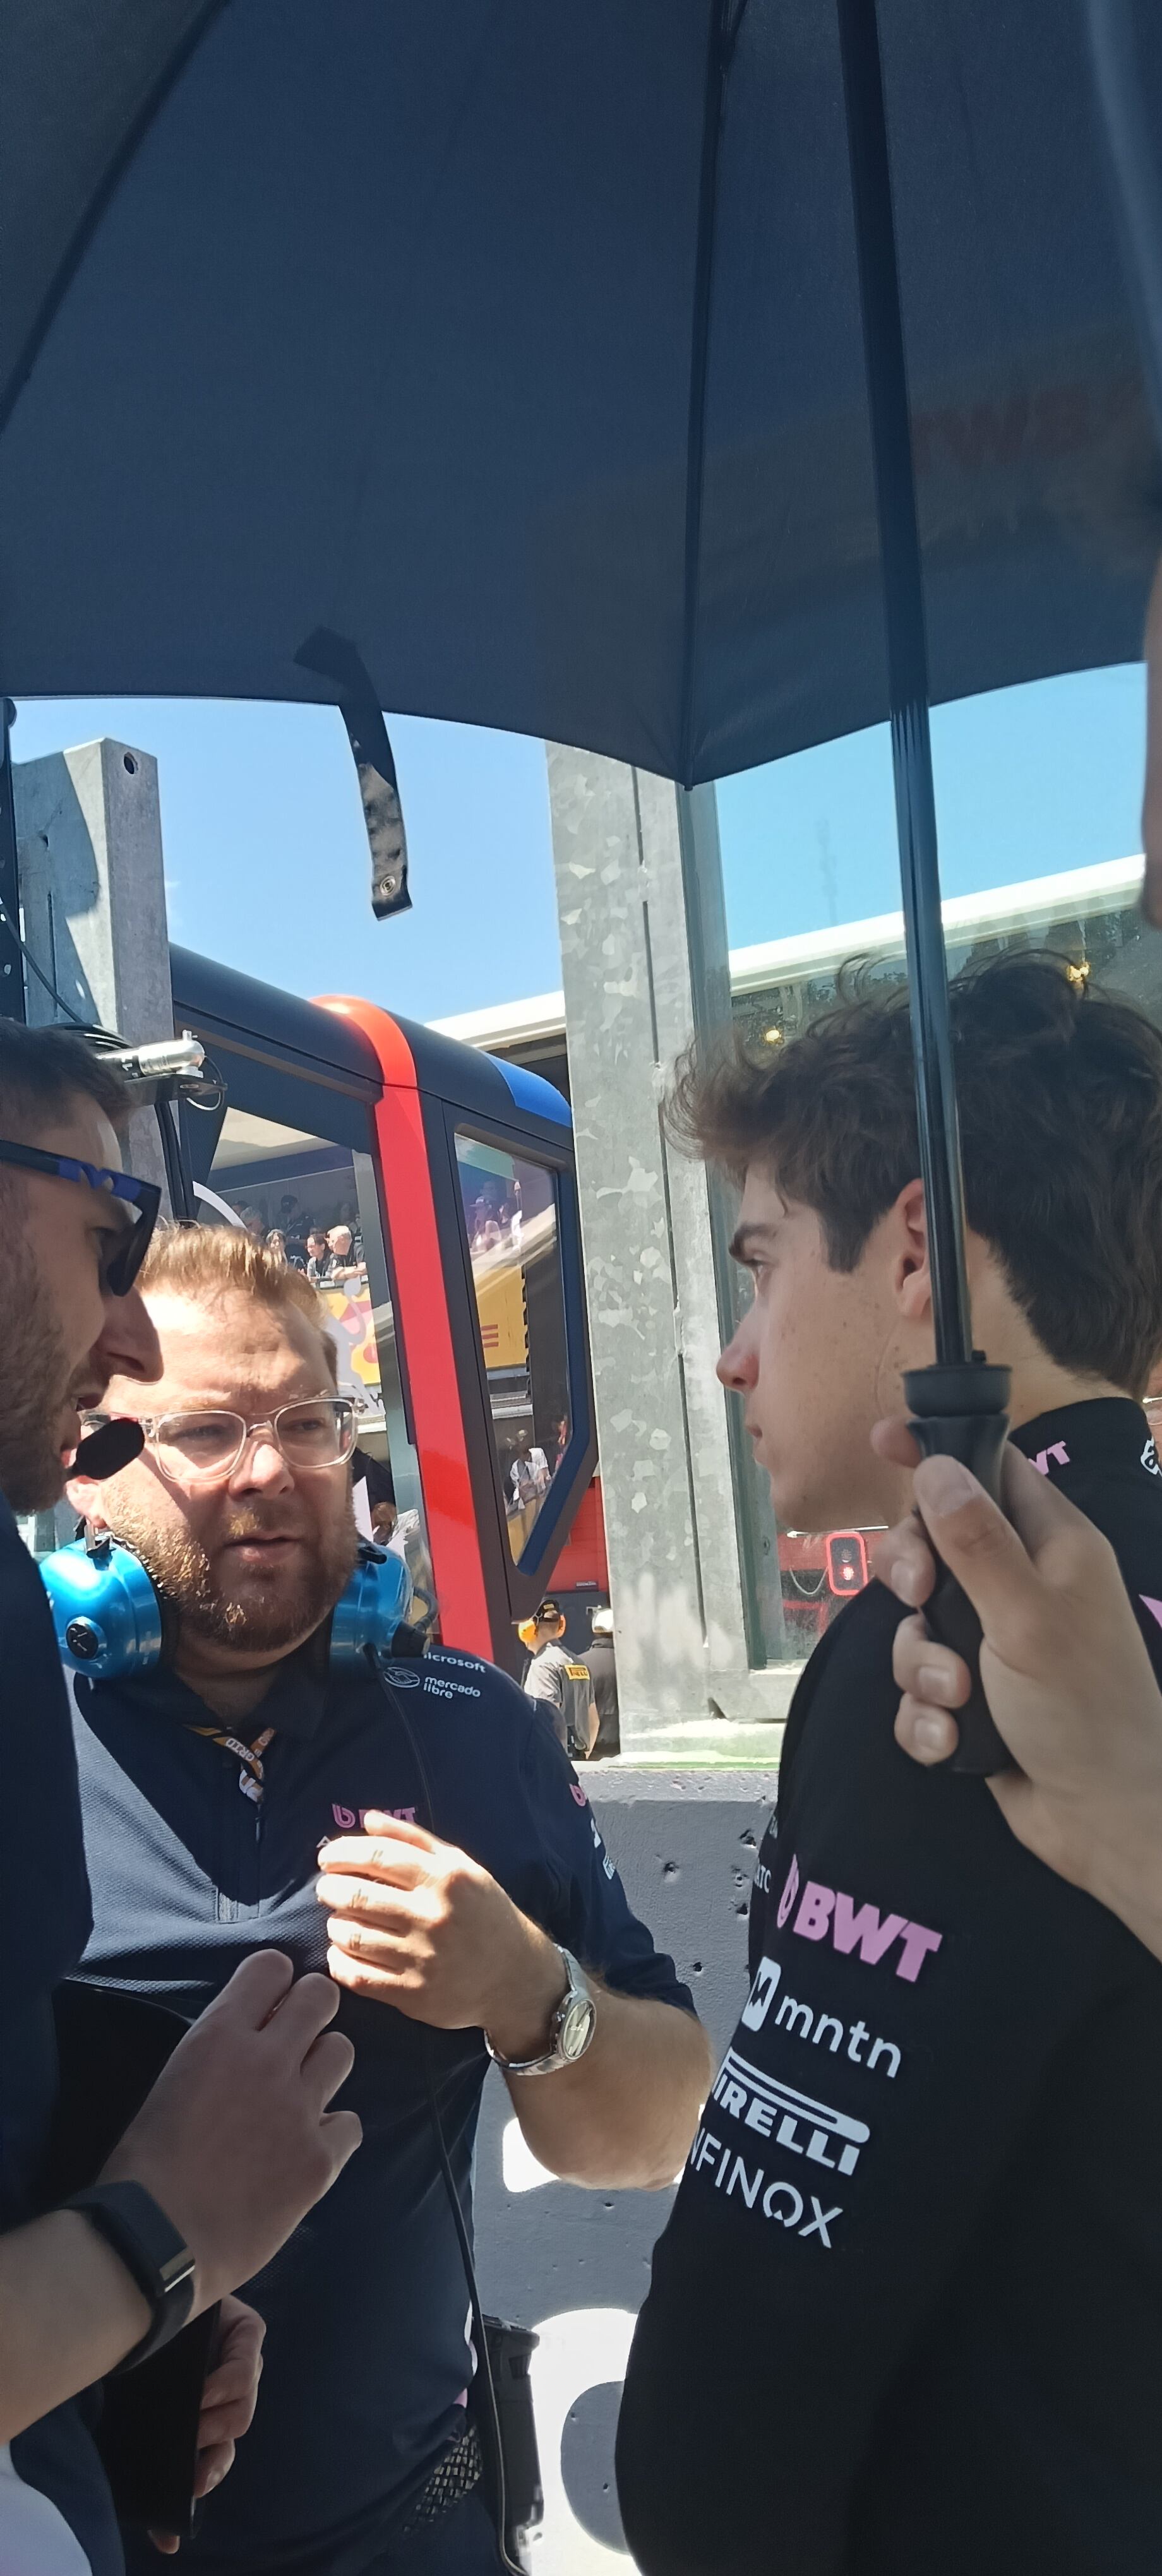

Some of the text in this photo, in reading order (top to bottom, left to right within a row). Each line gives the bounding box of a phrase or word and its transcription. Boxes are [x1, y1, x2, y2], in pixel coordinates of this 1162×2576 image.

[423, 1651, 486, 1673] icrosoft
[425, 1676, 481, 1698] mercado
[423, 1682, 453, 1700] libre
[793, 1880, 943, 1983] BWT
[774, 1994, 902, 2078] mntn
[690, 2127, 844, 2249] NFINOX
